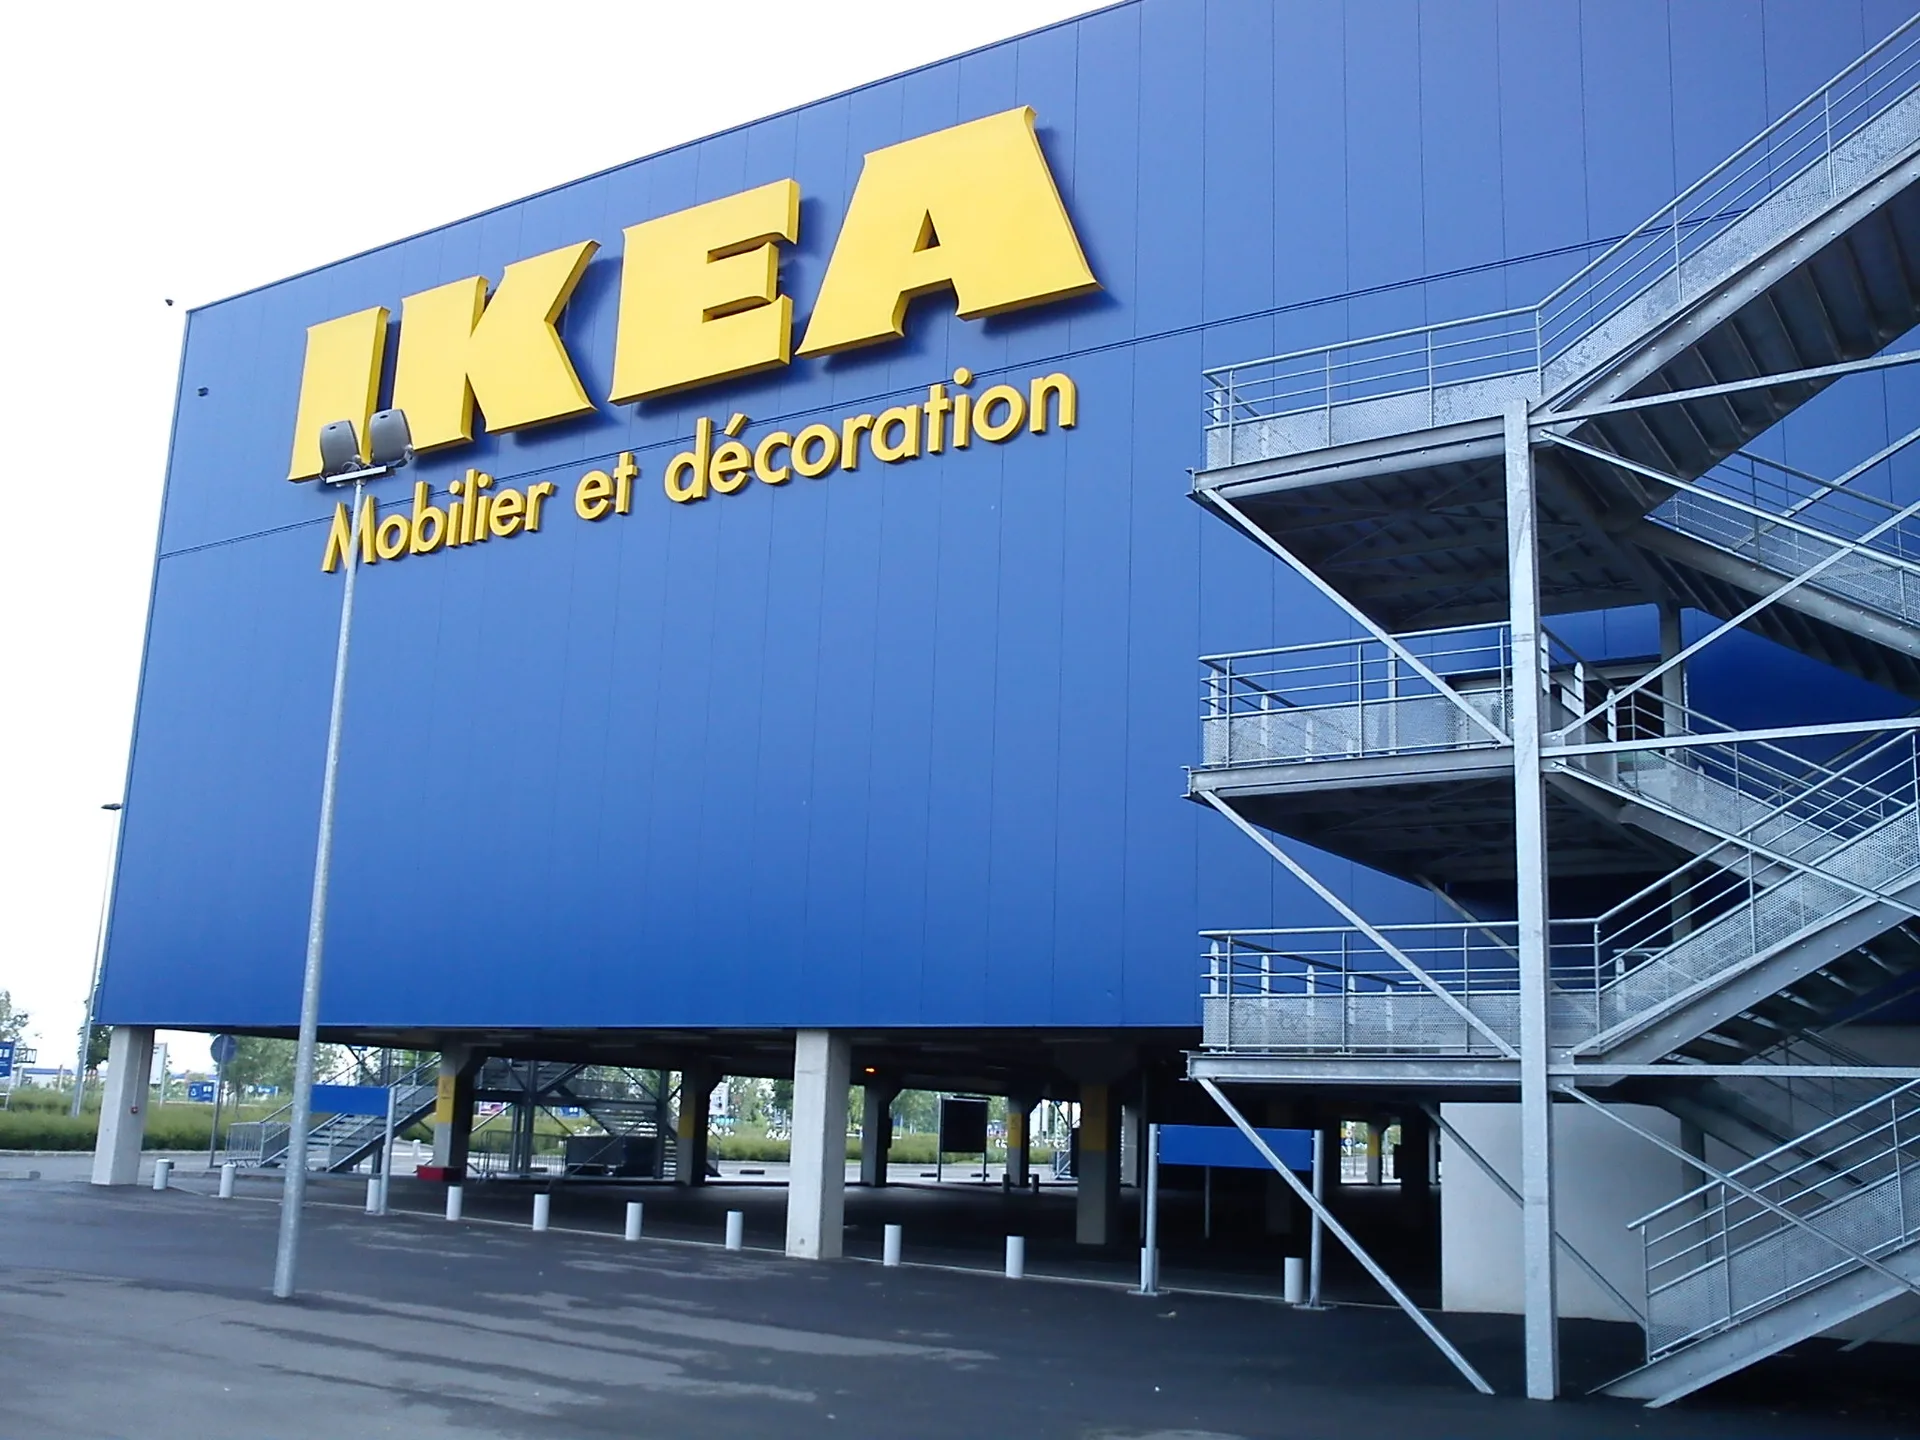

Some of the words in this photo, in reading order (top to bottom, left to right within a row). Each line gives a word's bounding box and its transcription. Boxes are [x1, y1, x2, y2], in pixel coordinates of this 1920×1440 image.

[288, 105, 1103, 482] IKEA
[322, 468, 555, 573] Mobilier
[574, 452, 639, 522] et
[664, 369, 1077, 505] décoration
